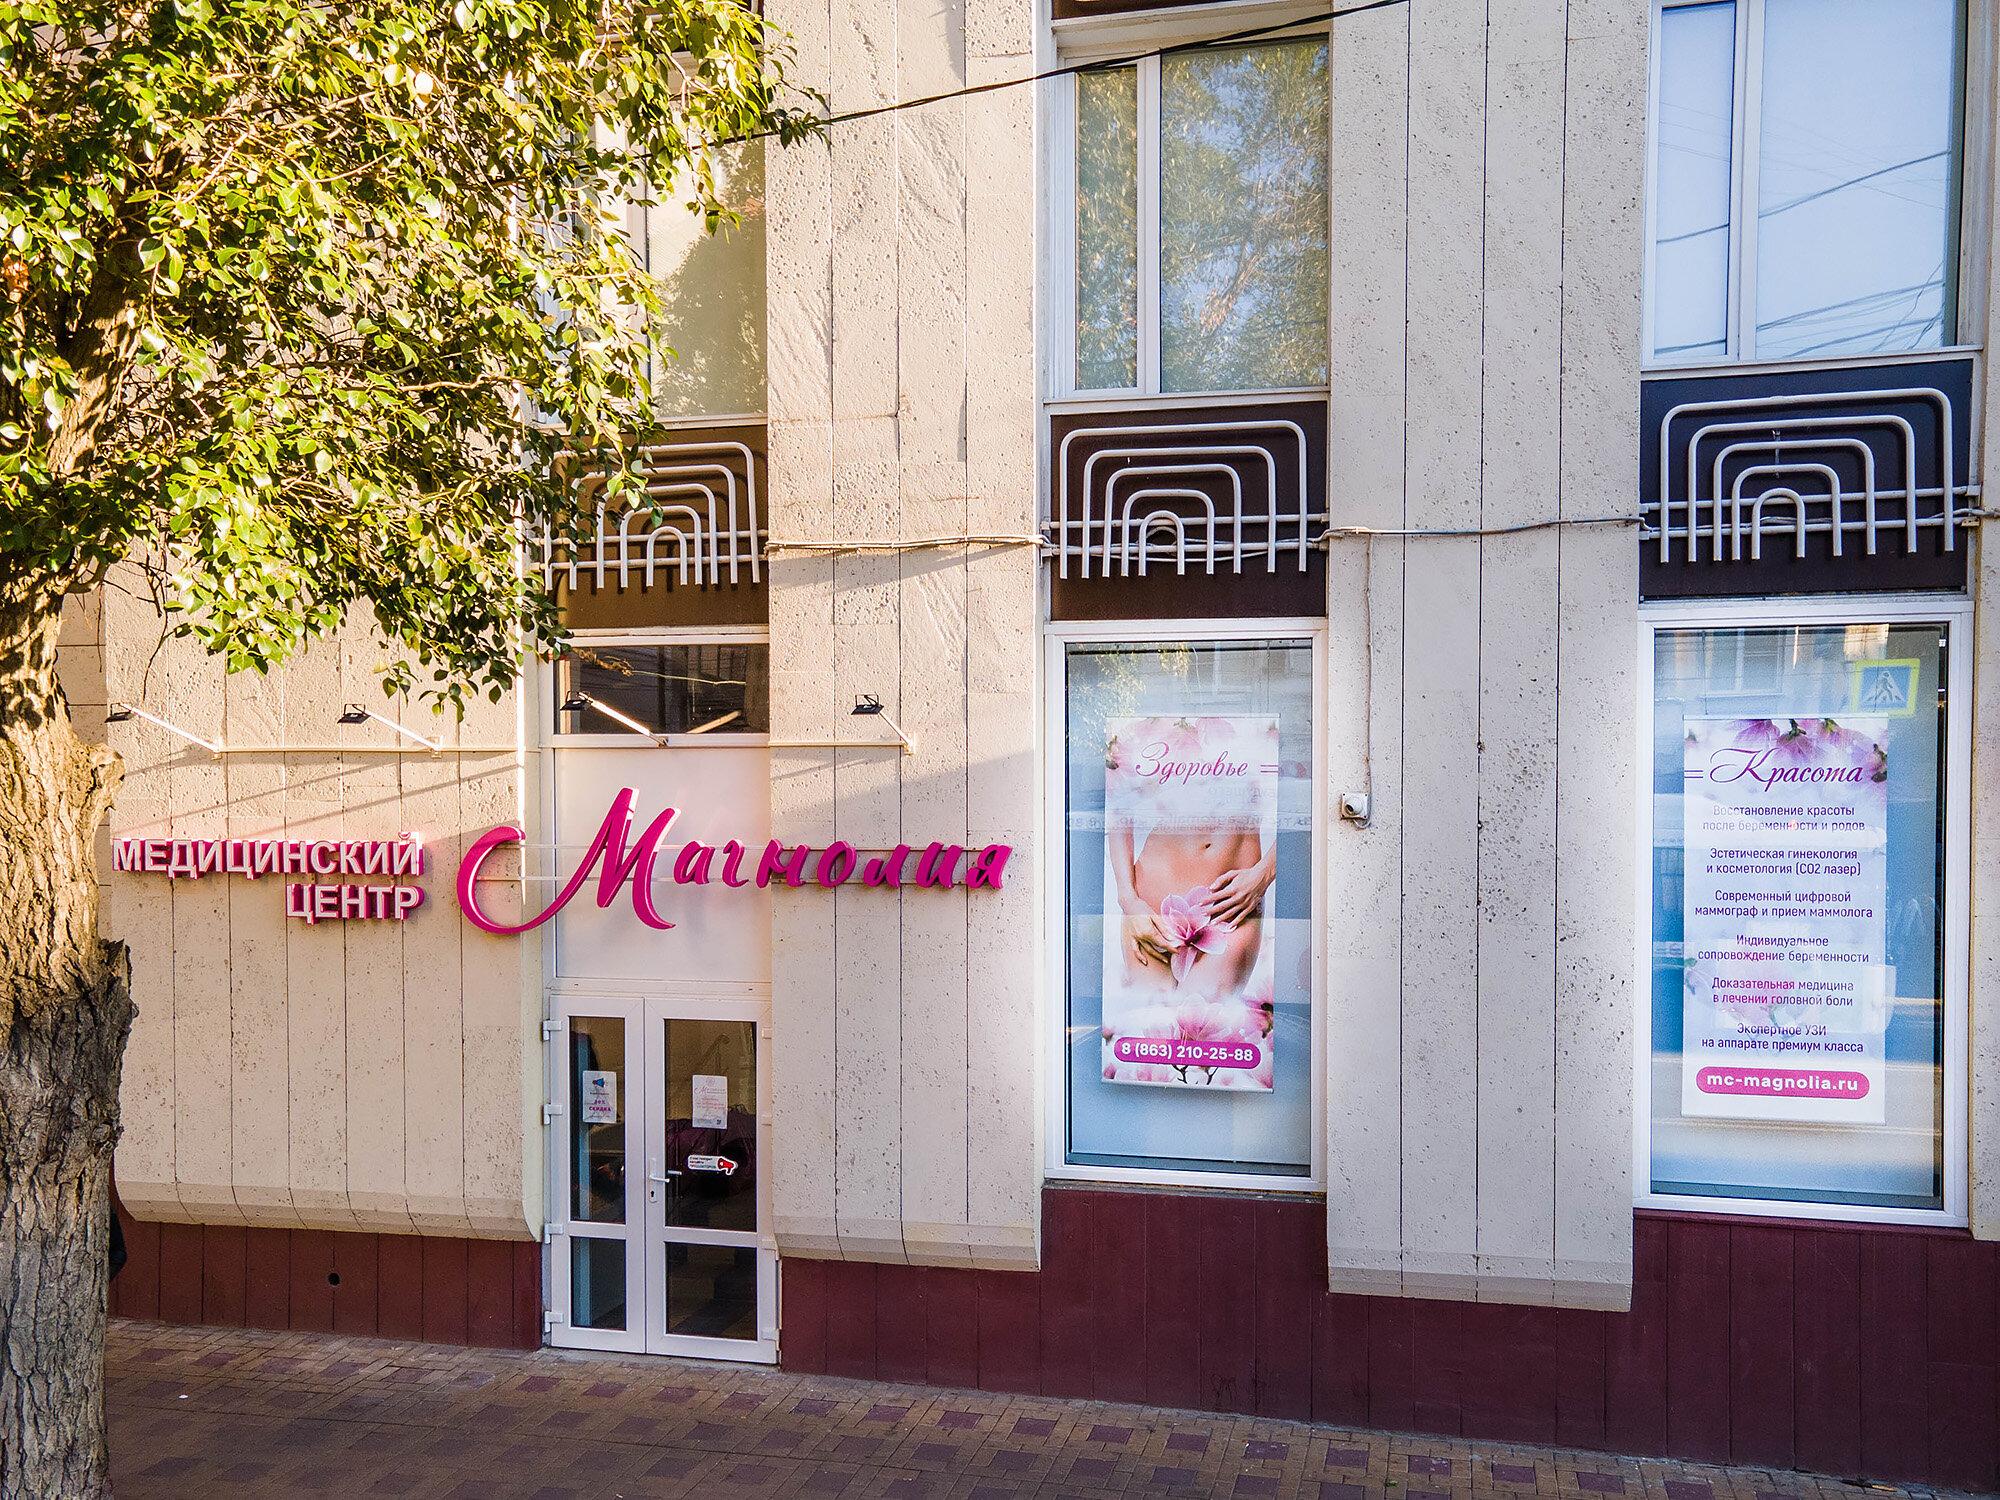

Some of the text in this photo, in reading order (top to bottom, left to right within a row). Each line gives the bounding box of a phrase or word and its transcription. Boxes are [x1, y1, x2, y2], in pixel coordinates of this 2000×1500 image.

[1135, 741, 1249, 785] Здоровье
[1709, 747, 1863, 792] Красота
[1713, 805, 1855, 818] Восстановление красоты
[1702, 821, 1735, 831] после
[1738, 820, 1818, 833] беременности
[1832, 822, 1866, 833] родов
[112, 832, 423, 879] МЕДИЦИНСКИЙ
[457, 787, 1012, 935] Магнолия
[1710, 847, 1858, 860] Эстетическая гинекология
[1716, 864, 1792, 875] косметология
[1823, 862, 1861, 876] лазер)
[286, 883, 424, 924] ЦЕНТР
[1715, 889, 1851, 904] Современный цифровой
[1695, 906, 1758, 918] маммограф
[1771, 907, 1806, 918] прием
[1809, 908, 1873, 919] маммолога
[1736, 934, 1829, 948] Индивидуальное
[1698, 950, 1869, 963] сопровождение беременности
[1712, 977, 1854, 992] Доказательная медицина
[1721, 994, 1768, 1004] лечении
[1771, 994, 1822, 1006] головной
[1825, 994, 1853, 1006] боли
[1737, 1023, 1827, 1037] Экспертное УЗИ
[1121, 1042, 1254, 1062] 8 (863) 210-25-88
[1701, 1038, 1864, 1053] на аппарате премиум класса
[1706, 1073, 1858, 1091] mc-magnolia.ru
